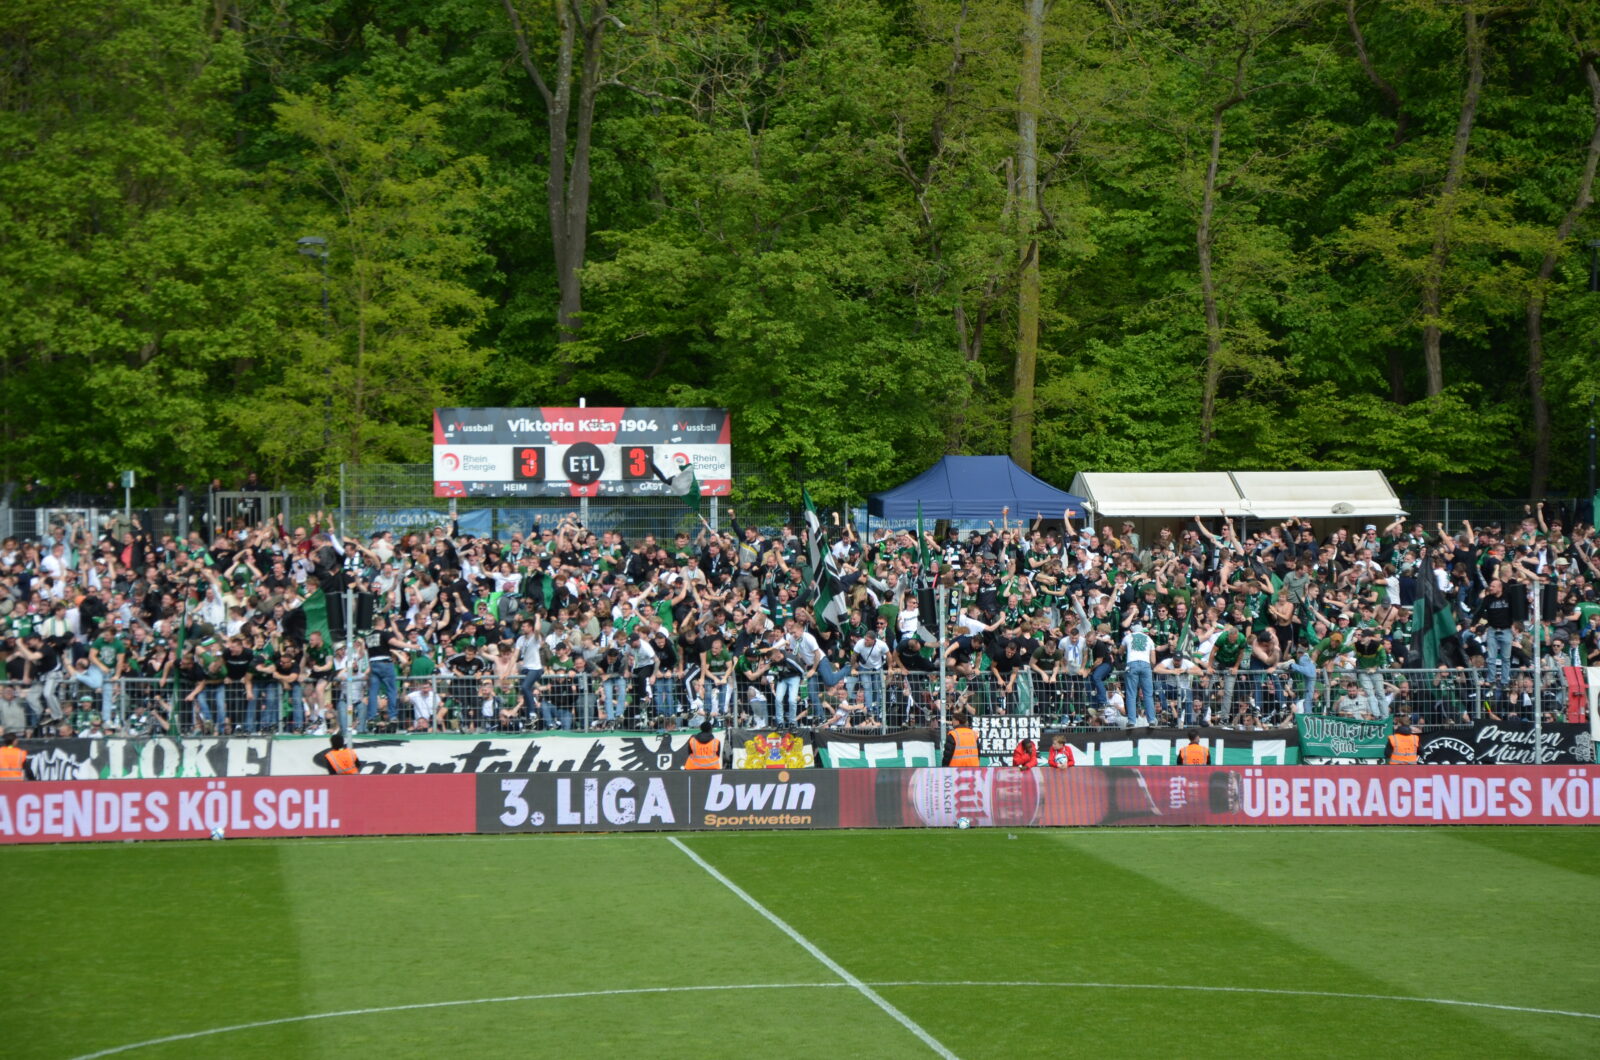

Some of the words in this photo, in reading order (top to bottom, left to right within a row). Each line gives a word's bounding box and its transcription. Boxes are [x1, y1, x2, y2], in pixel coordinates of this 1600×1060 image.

[507, 418, 574, 432] Viktoria
[620, 420, 658, 432] 1904
[463, 455, 488, 463] Rhein
[521, 448, 538, 477] 3
[629, 447, 646, 477] 3
[692, 454, 717, 462] Rhein
[463, 463, 496, 472] Energie
[503, 483, 527, 491] HEIM
[972, 716, 1040, 728] SEKTION
[1476, 725, 1564, 745] Preußen
[978, 739, 1040, 750] ERBT
[704, 770, 816, 811] bwin
[944, 775, 952, 814] KÖLSCH
[1242, 768, 1532, 820] ÜBERRAGENDES
[179, 781, 340, 831] KÖLSCH.
[500, 778, 545, 827] 3.
[556, 776, 675, 825] LIGA
[704, 813, 812, 828] Sportwetten
